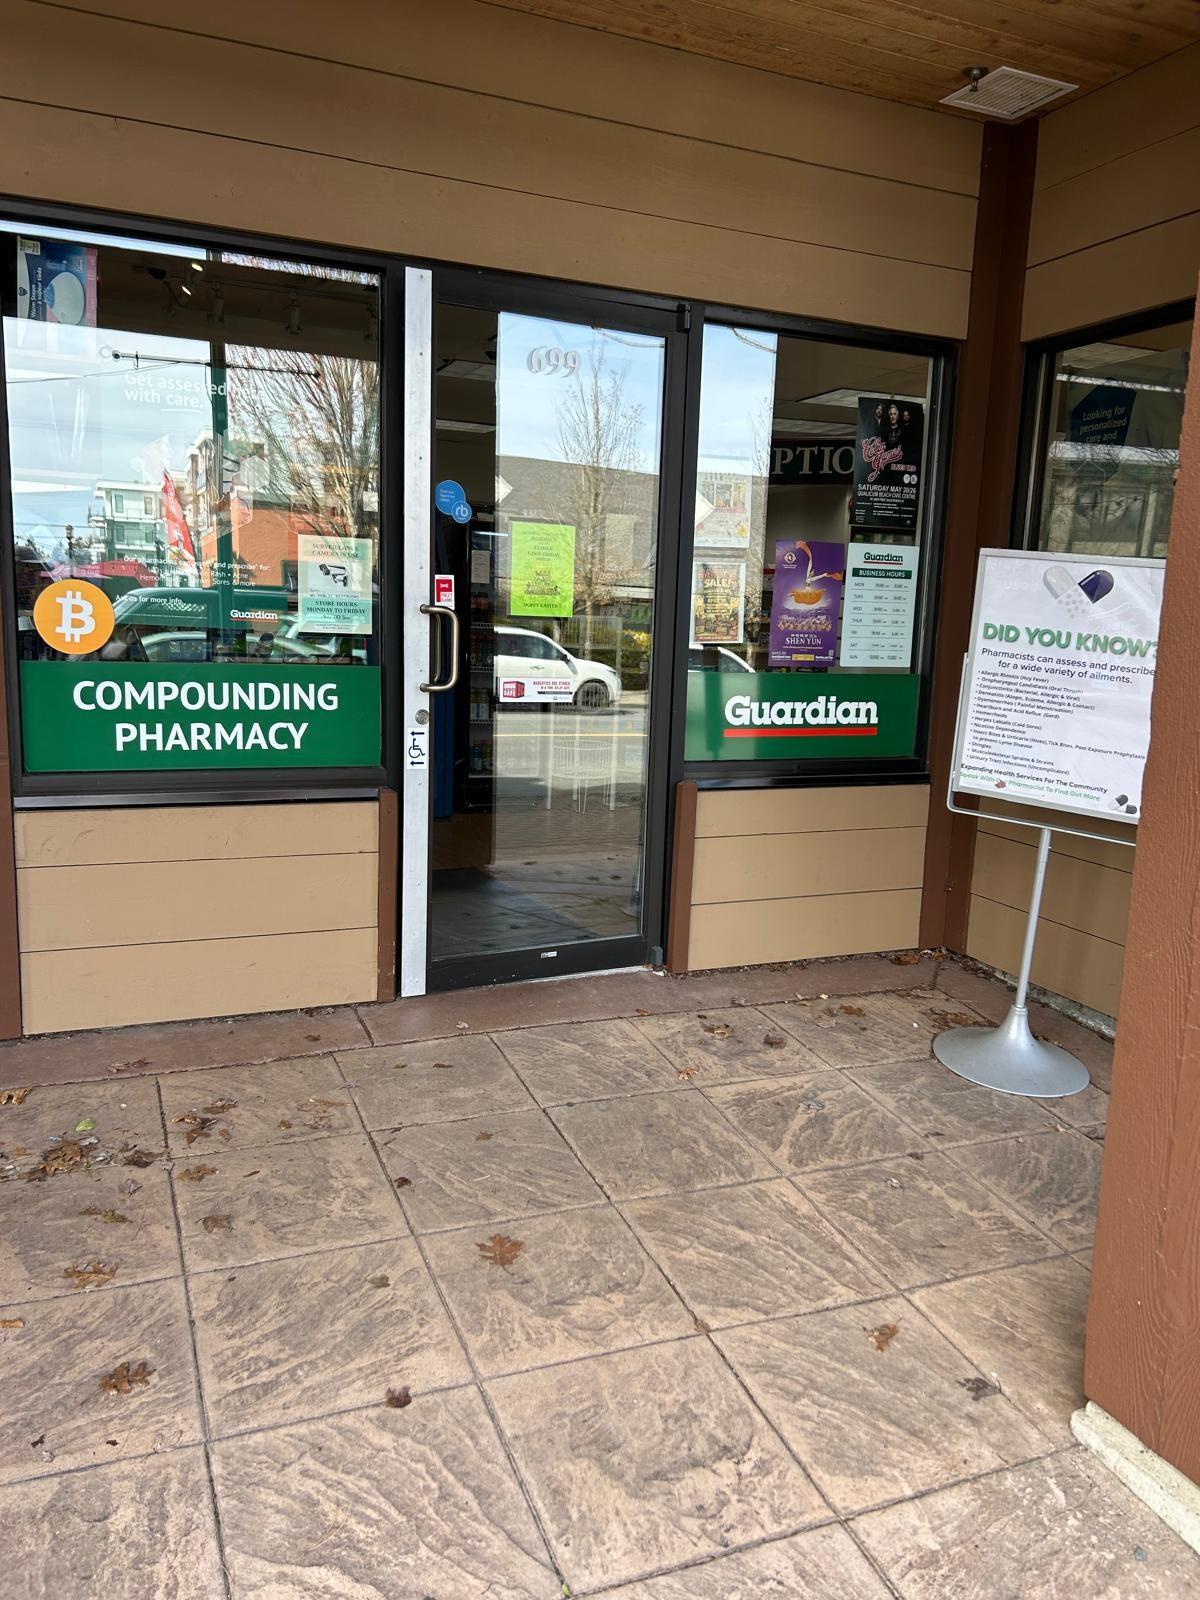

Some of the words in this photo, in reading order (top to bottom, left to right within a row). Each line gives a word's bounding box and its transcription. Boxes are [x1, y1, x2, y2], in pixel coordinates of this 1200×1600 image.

[527, 345, 581, 378] 699
[125, 372, 152, 387] Get
[124, 388, 160, 404] with
[166, 394, 204, 408] care.
[1083, 409, 1112, 421] Looking
[1114, 406, 1126, 416] for
[1080, 416, 1127, 435] personalized
[1102, 430, 1118, 440] and
[771, 446, 856, 474] PTIO
[858, 484, 890, 492] SATURDAY
[864, 552, 903, 562] Guardian
[230, 610, 278, 619] Guardian
[982, 622, 1020, 643] DID
[1025, 626, 1072, 649] YOU
[982, 647, 1035, 662] Pharmacists
[1036, 655, 1053, 664] can
[1056, 657, 1087, 668] assess
[1089, 660, 1108, 670] and
[1109, 664, 1156, 676] prescribe
[998, 660, 1010, 669] for
[1020, 663, 1042, 673] wide
[1044, 666, 1076, 678] variety
[1078, 669, 1088, 678] of
[1089, 671, 1134, 684] ailments.
[72, 680, 339, 711] COMPOUNDING
[724, 696, 878, 726] Guardian
[115, 722, 309, 752] PHARMACY
[961, 763, 993, 774] Expanding
[994, 768, 1015, 778] Health
[1016, 772, 1043, 782] Services
[1069, 781, 1108, 794] Community
[1083, 792, 1100, 801] More
